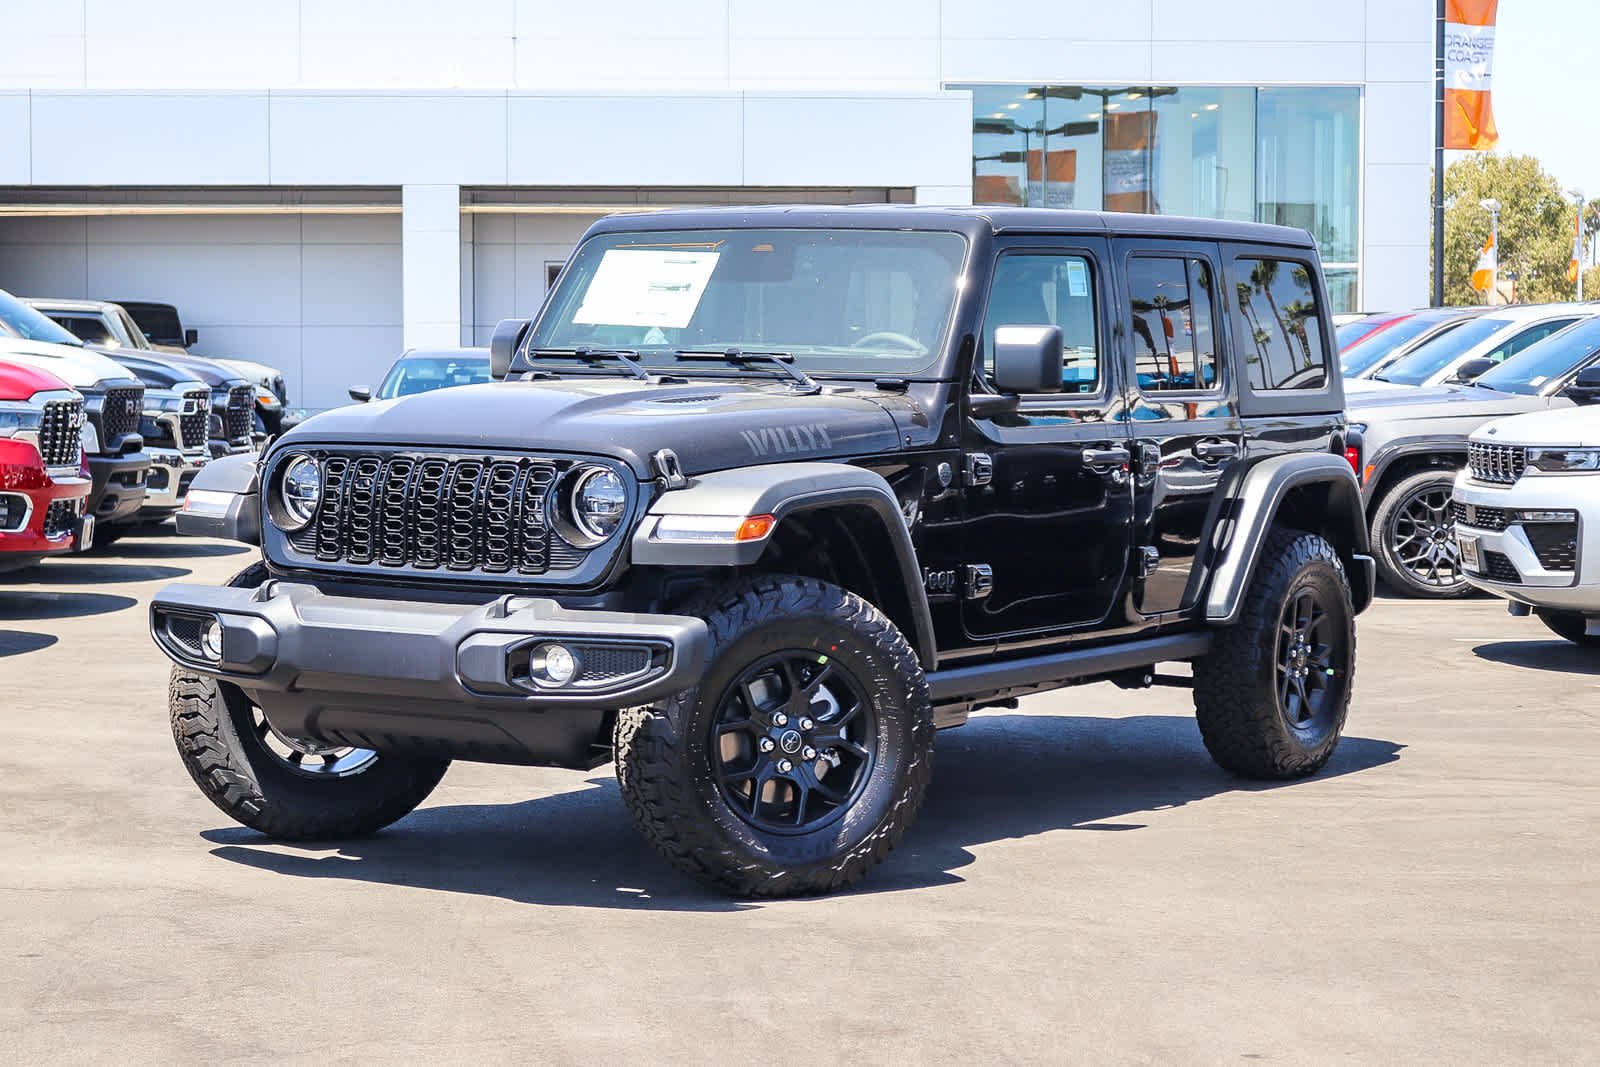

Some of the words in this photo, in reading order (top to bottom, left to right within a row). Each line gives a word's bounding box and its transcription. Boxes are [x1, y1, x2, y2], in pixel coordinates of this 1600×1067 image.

[1447, 49, 1489, 64] COAST
[740, 424, 832, 456] WILLYS
[923, 566, 955, 592] Jeep
